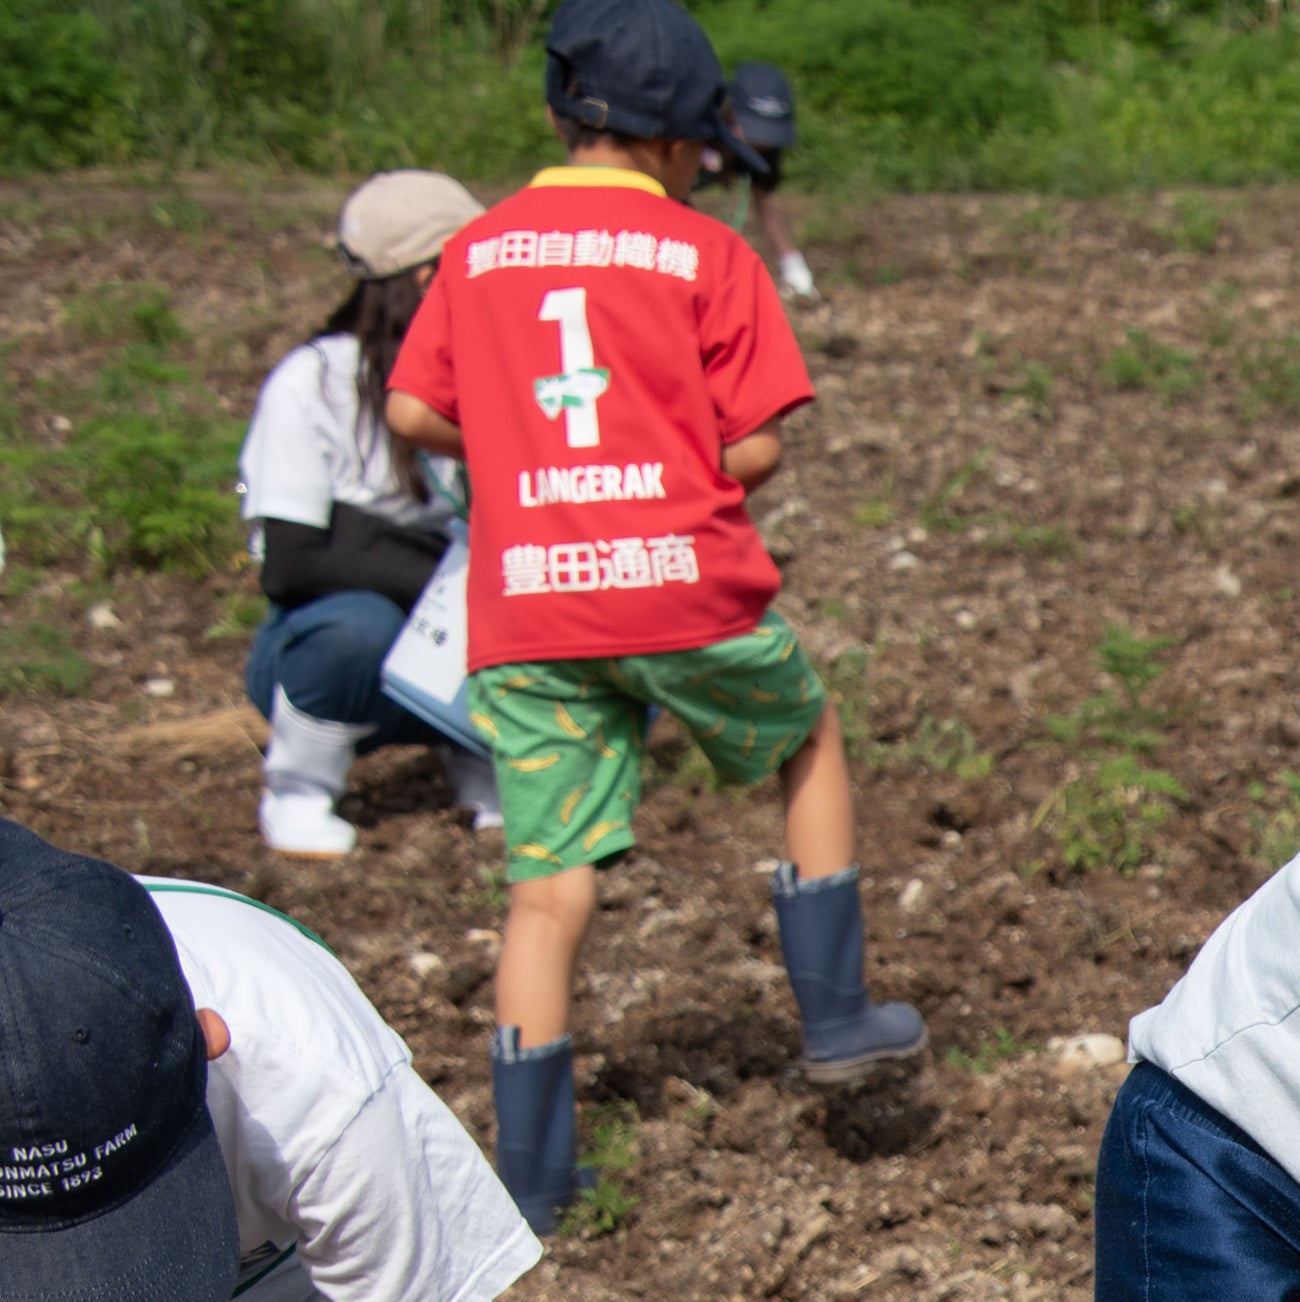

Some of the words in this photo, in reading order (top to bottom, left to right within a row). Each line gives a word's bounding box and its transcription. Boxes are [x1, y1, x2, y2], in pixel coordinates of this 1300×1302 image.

[538, 286, 600, 449] 1
[518, 462, 666, 507] LANGERAK
[501, 532, 699, 597] 豊田通商
[13, 1139, 68, 1162] NASU
[94, 1122, 138, 1160] FARM
[62, 1166, 103, 1191] 1893
